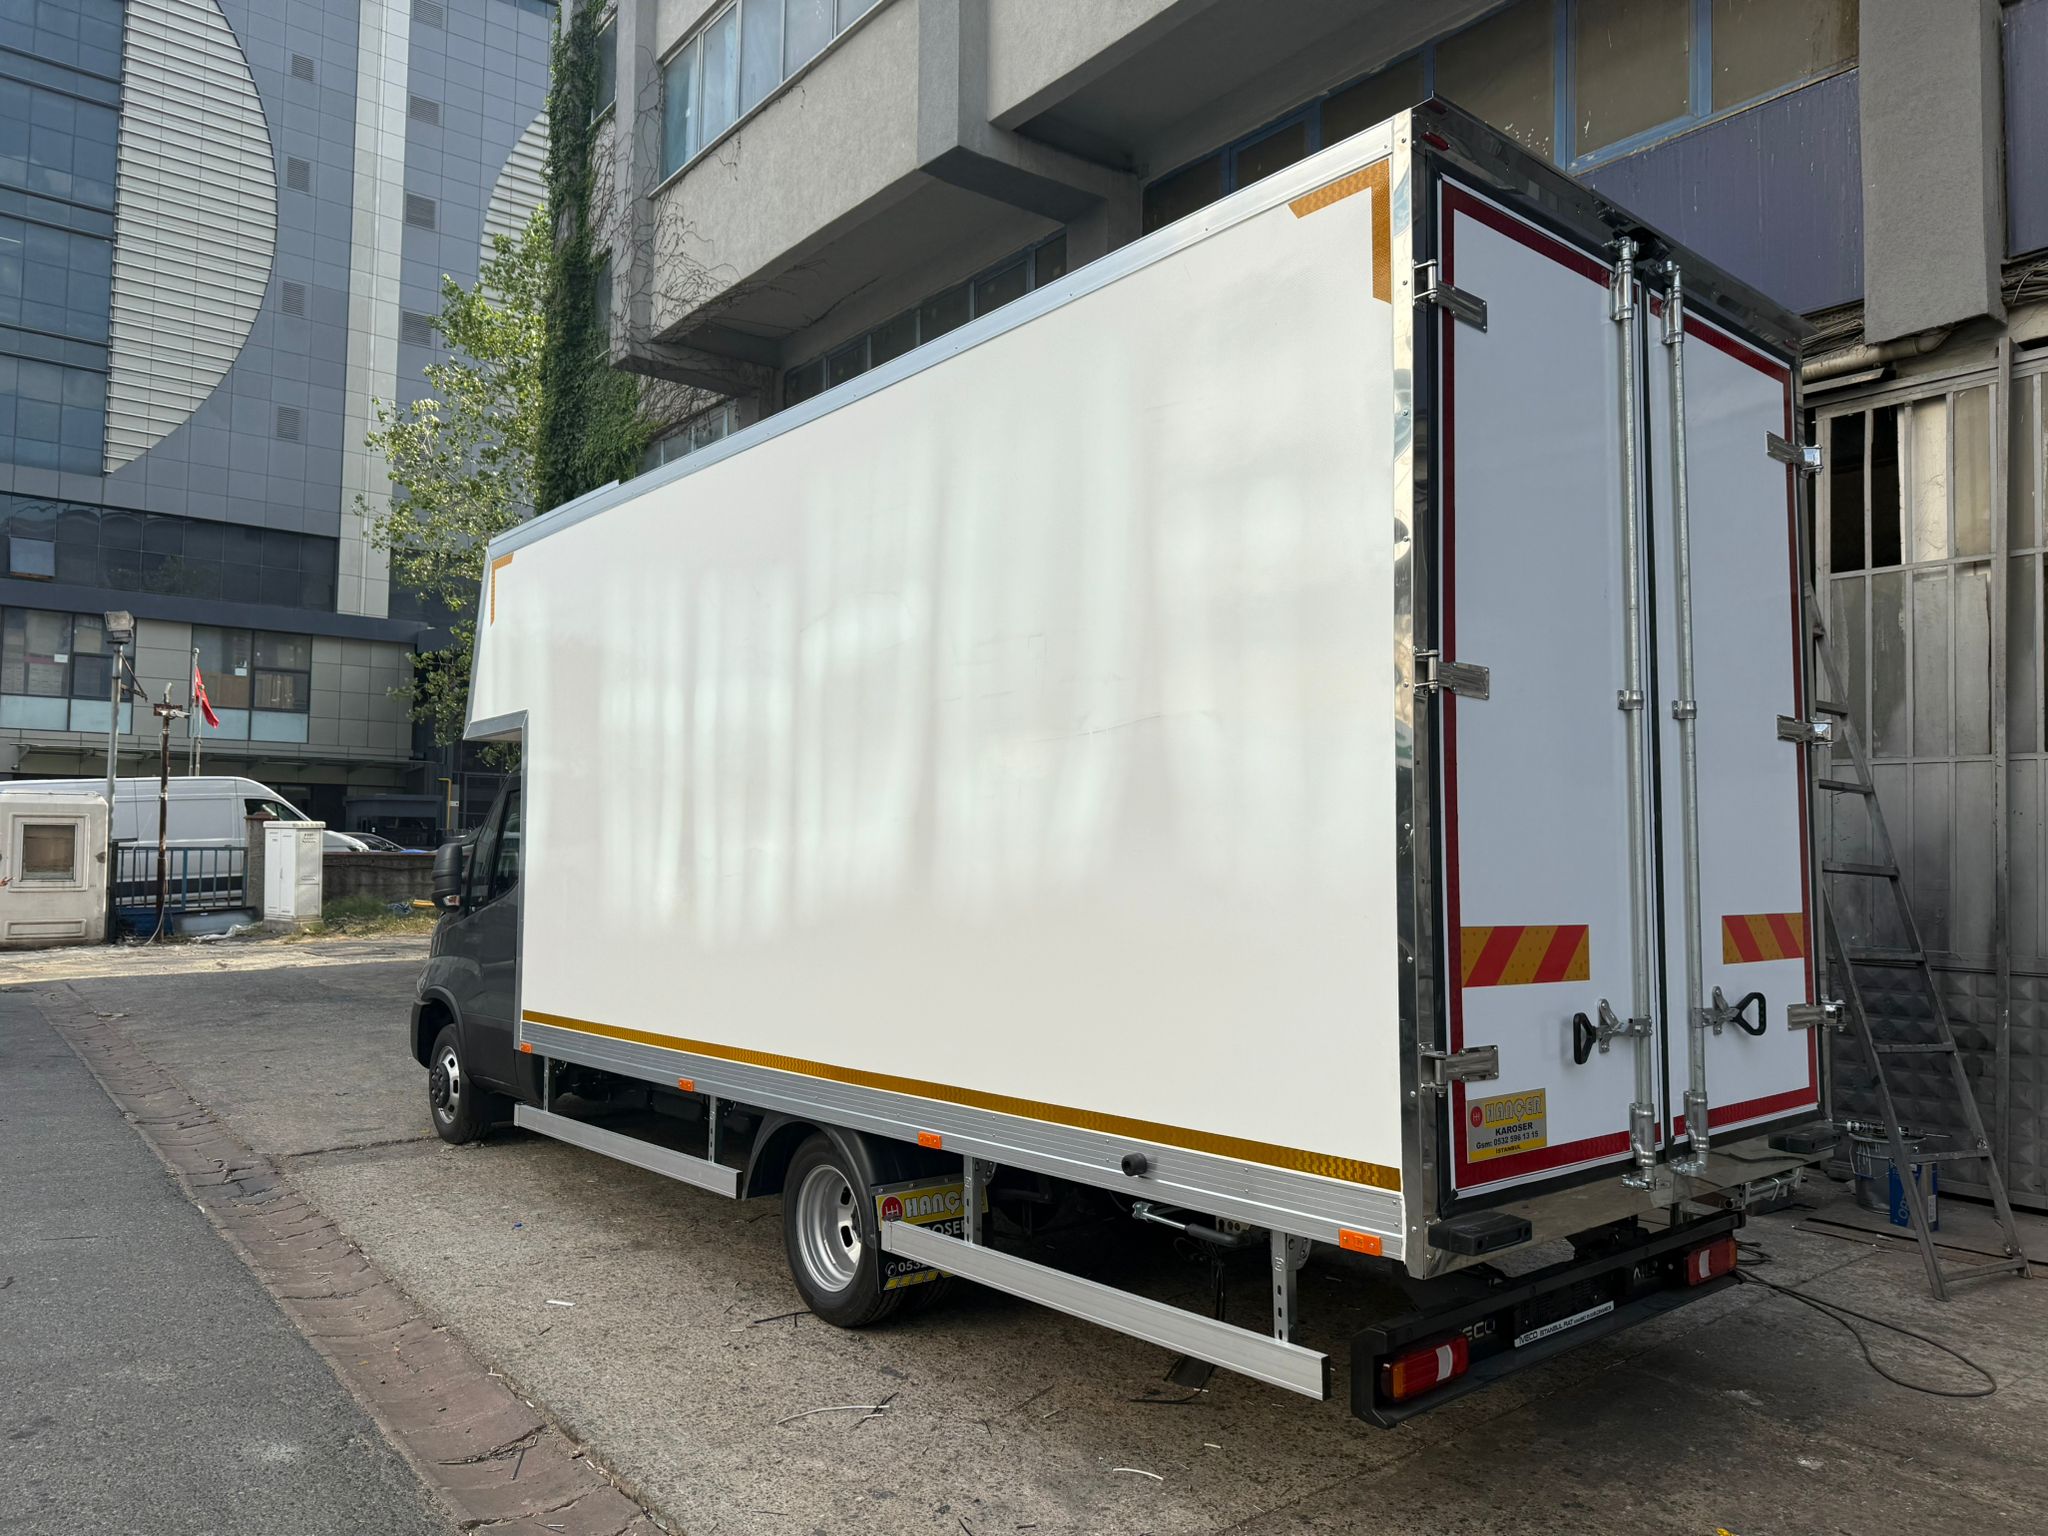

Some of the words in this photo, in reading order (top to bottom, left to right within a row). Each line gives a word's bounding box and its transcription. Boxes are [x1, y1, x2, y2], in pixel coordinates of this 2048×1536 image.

[1495, 1121, 1533, 1136] KAROSER
[1493, 1136, 1509, 1146] 0532
[1522, 1132, 1530, 1140] 13
[1531, 1130, 1539, 1138] 15
[905, 1191, 964, 1218] HANÇ
[1519, 1331, 1538, 1345] IVECO
